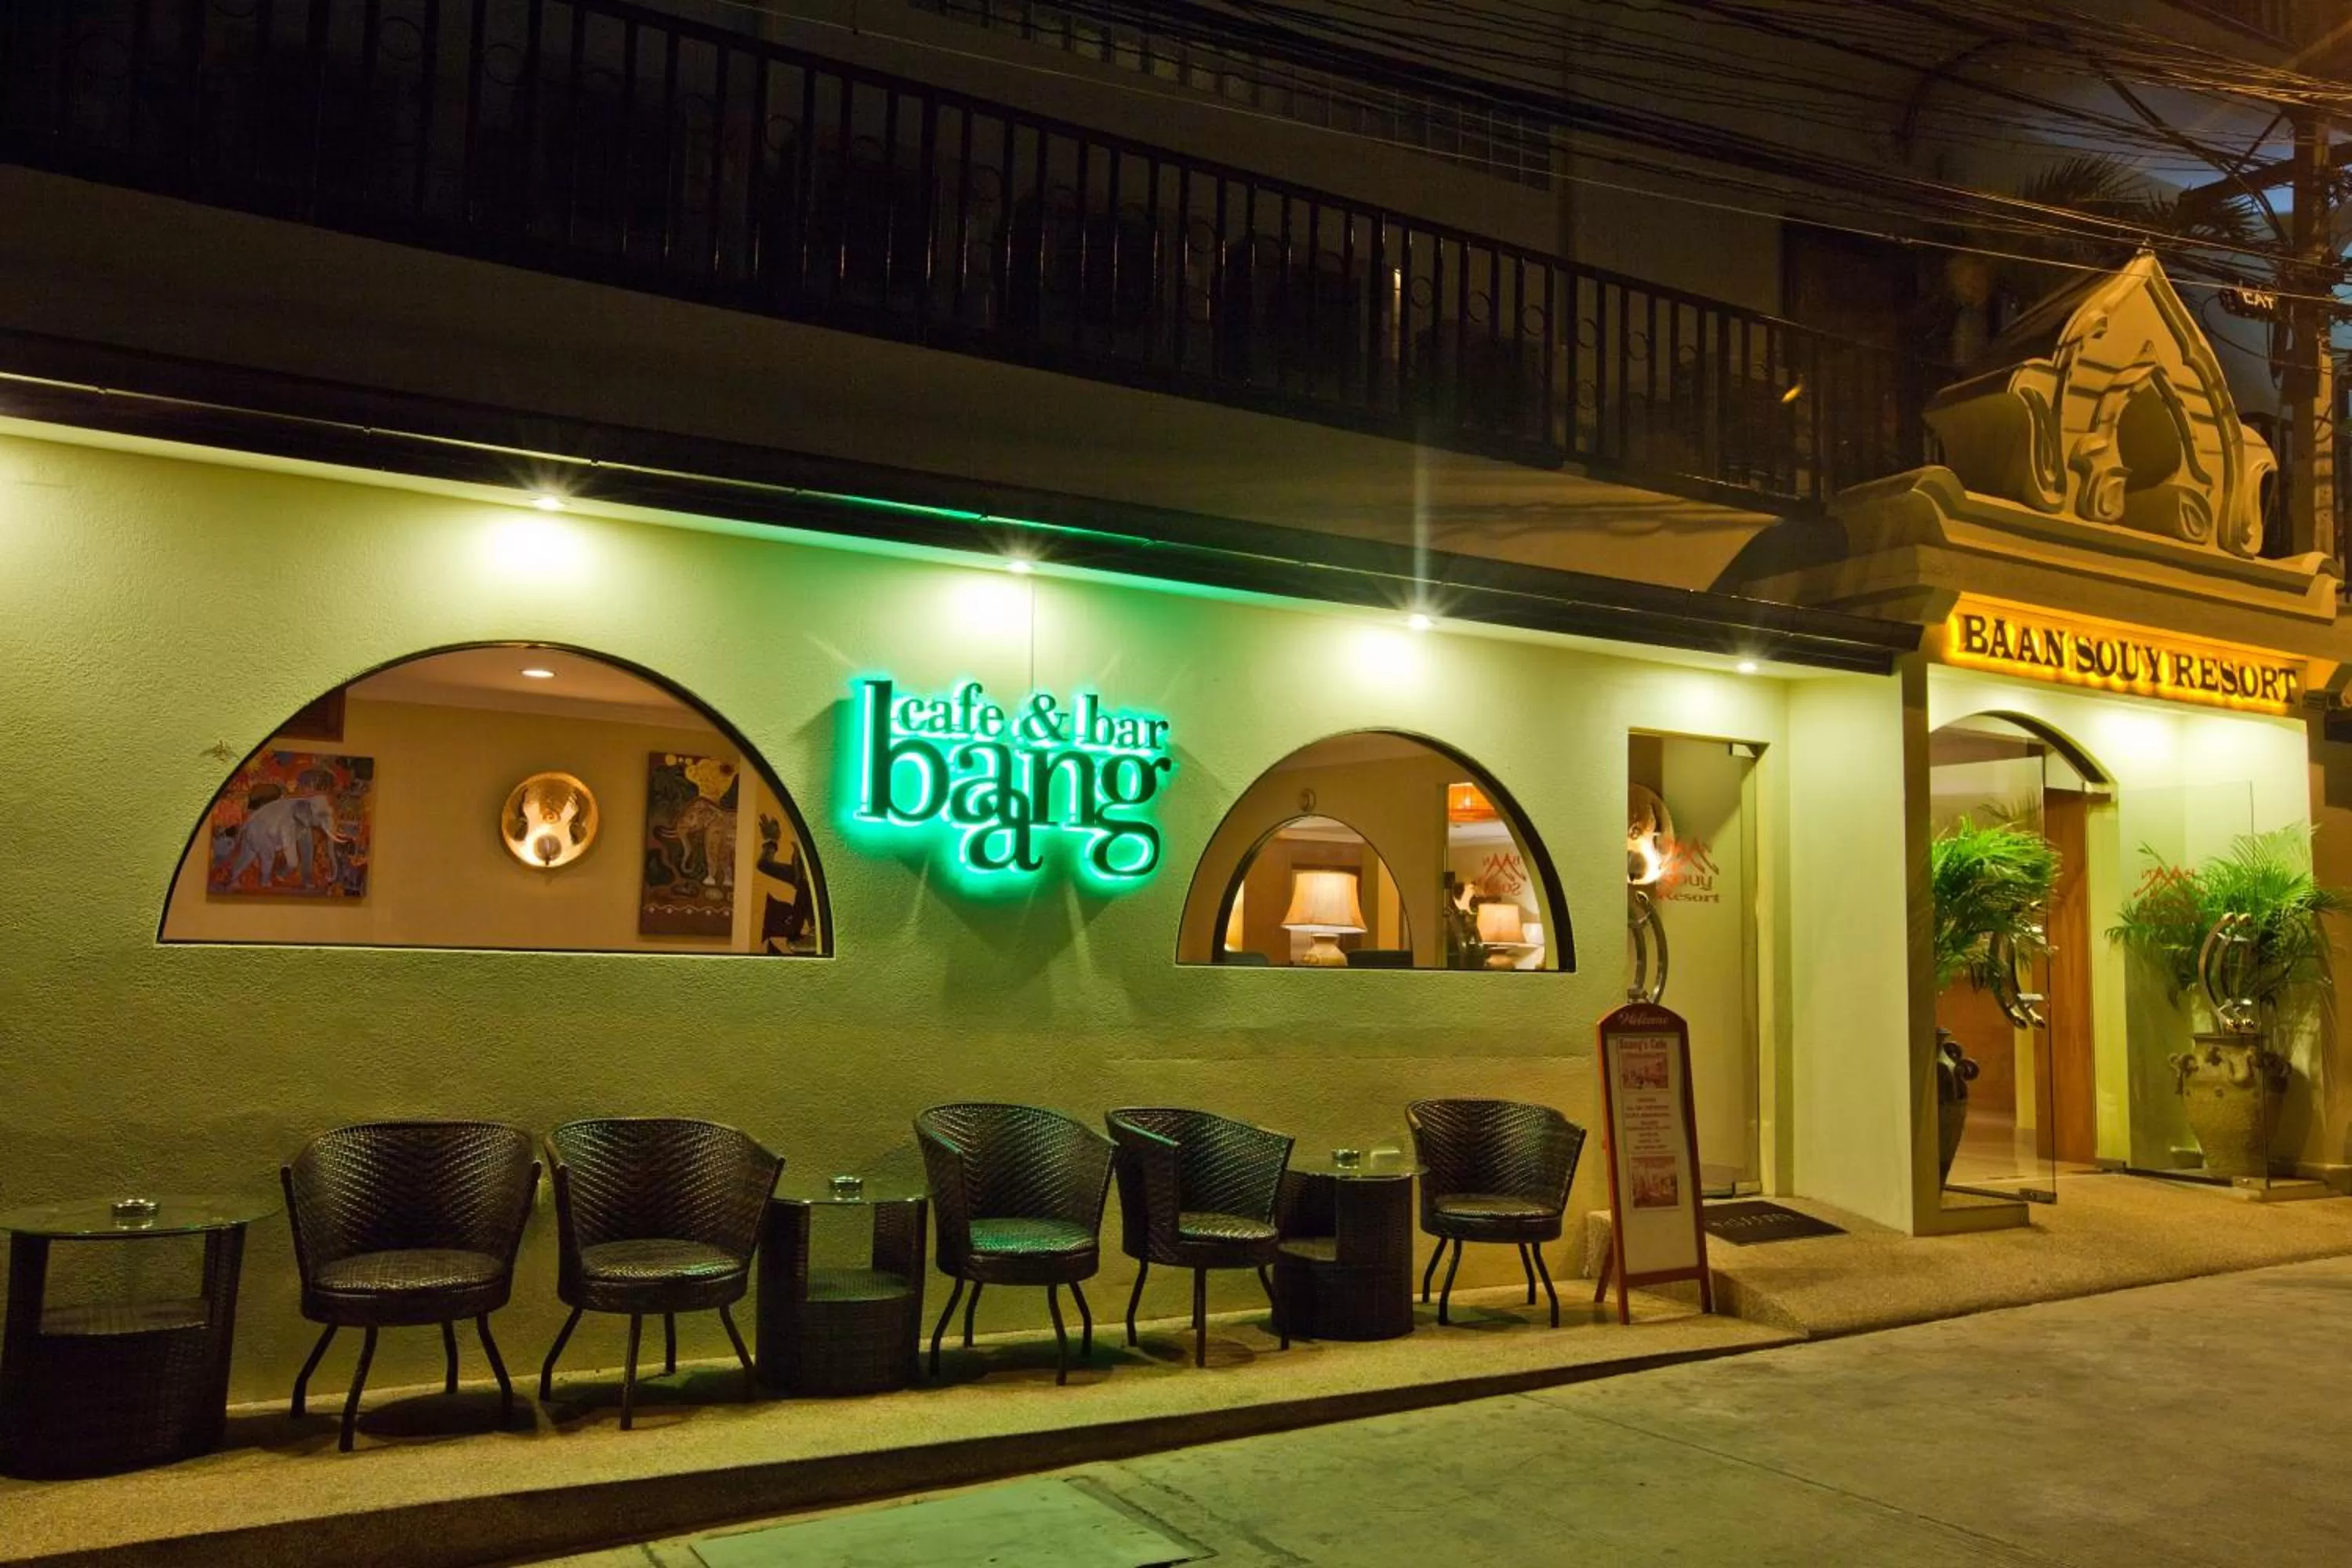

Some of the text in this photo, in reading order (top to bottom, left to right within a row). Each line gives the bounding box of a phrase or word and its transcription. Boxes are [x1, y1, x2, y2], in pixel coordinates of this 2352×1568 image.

[1963, 614, 2296, 704] BAAN SOUY RESORT
[895, 682, 1169, 750] cafe & bar
